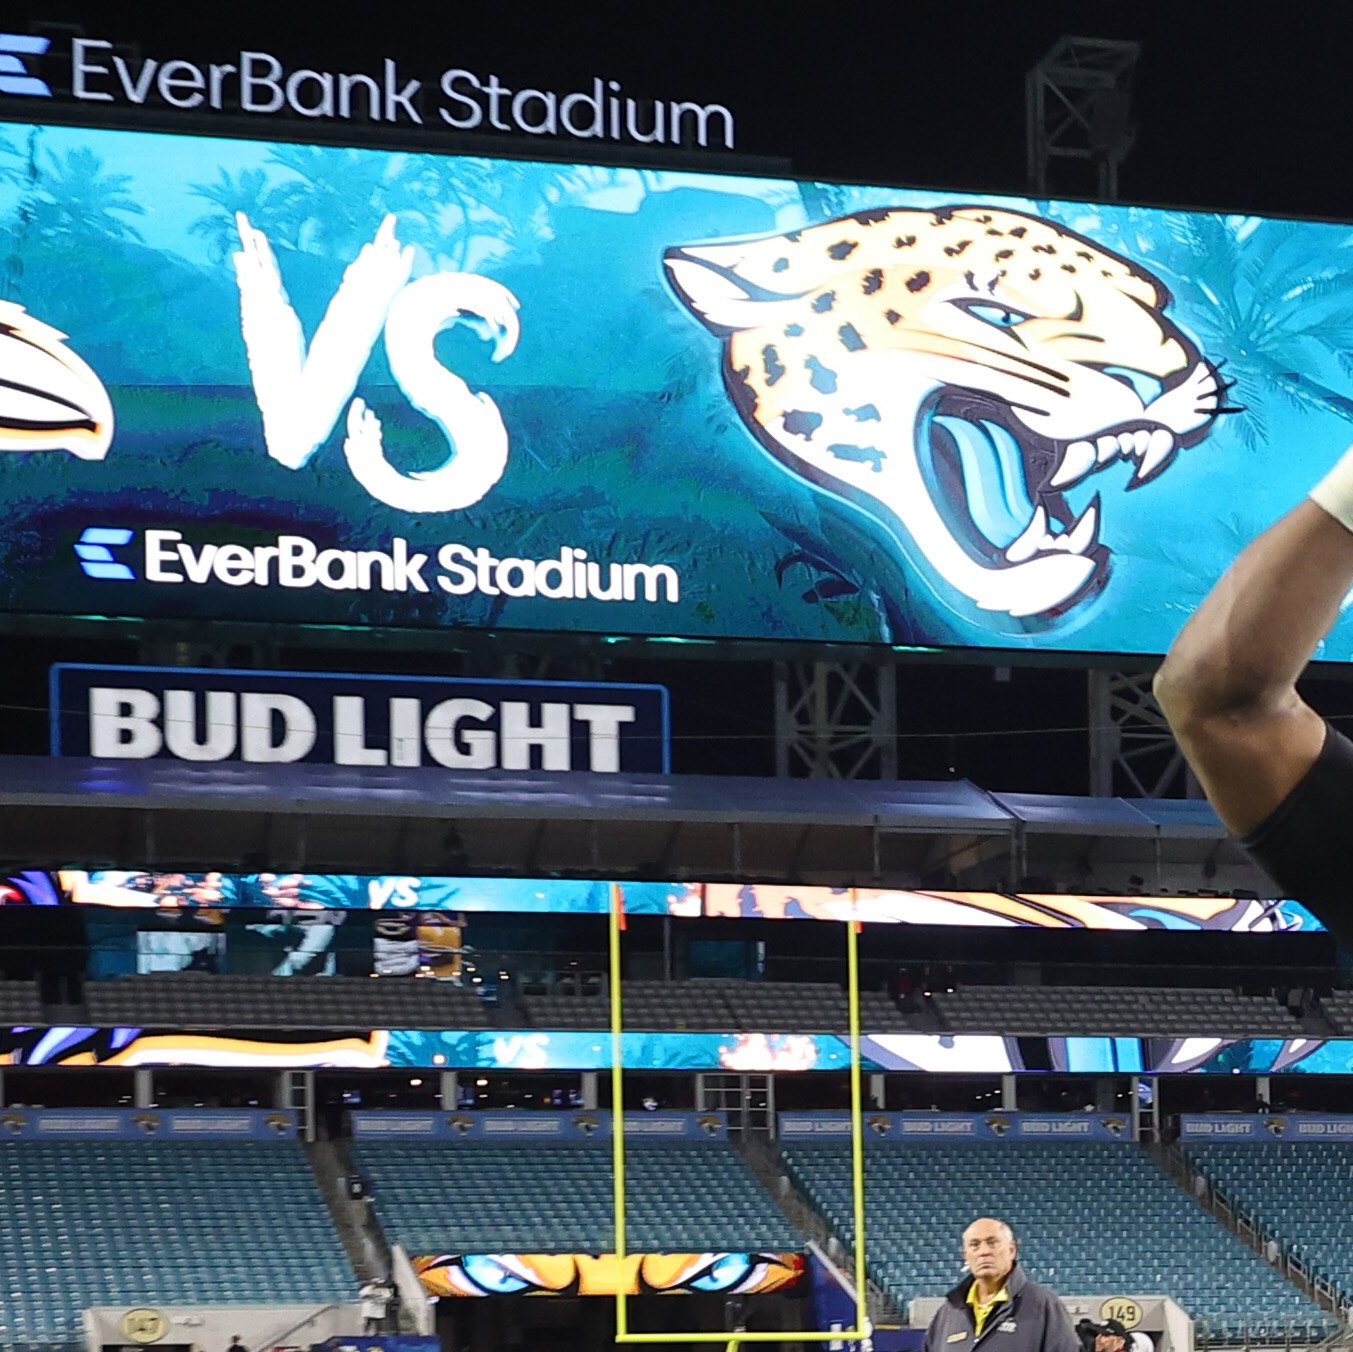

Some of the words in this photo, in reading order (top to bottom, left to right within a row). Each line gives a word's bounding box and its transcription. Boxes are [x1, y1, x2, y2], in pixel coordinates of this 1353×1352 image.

[71, 37, 422, 125] EverBank
[439, 68, 735, 149] Stadium
[233, 212, 521, 513] VS
[144, 529, 430, 594] EverBank
[436, 543, 680, 603] Stadium
[89, 687, 317, 764] BUD
[332, 695, 636, 774] LIGHT
[368, 876, 422, 910] VS
[493, 1033, 550, 1069] VS
[1108, 1305, 1136, 1322] 149
